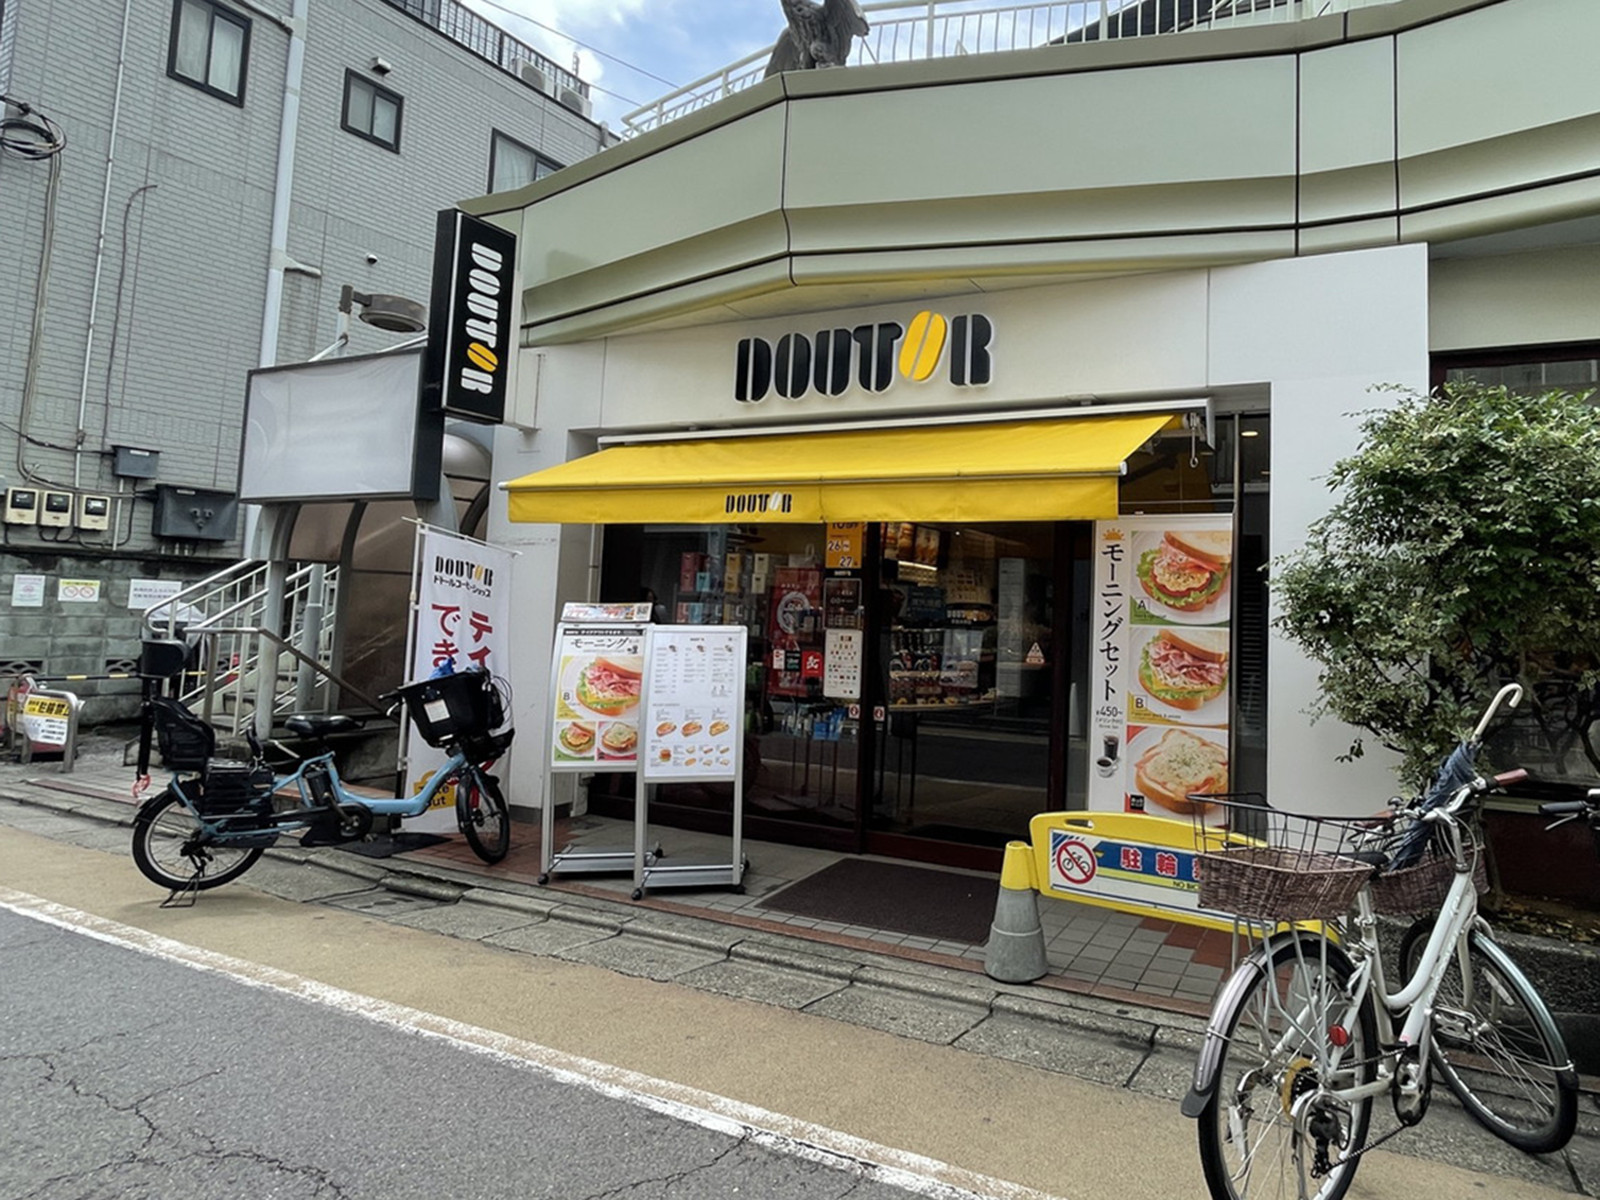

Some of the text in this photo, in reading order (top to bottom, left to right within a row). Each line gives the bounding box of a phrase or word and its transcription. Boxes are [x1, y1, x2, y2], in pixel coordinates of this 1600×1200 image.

[461, 242, 503, 394] DOUTOR
[734, 310, 993, 402] DOUTOR
[725, 491, 792, 513] DOUTOR
[435, 555, 493, 587] DOUTOR
[1137, 600, 1146, 610] A
[1098, 543, 1125, 702] モーニングセット
[1135, 698, 1144, 708] B
